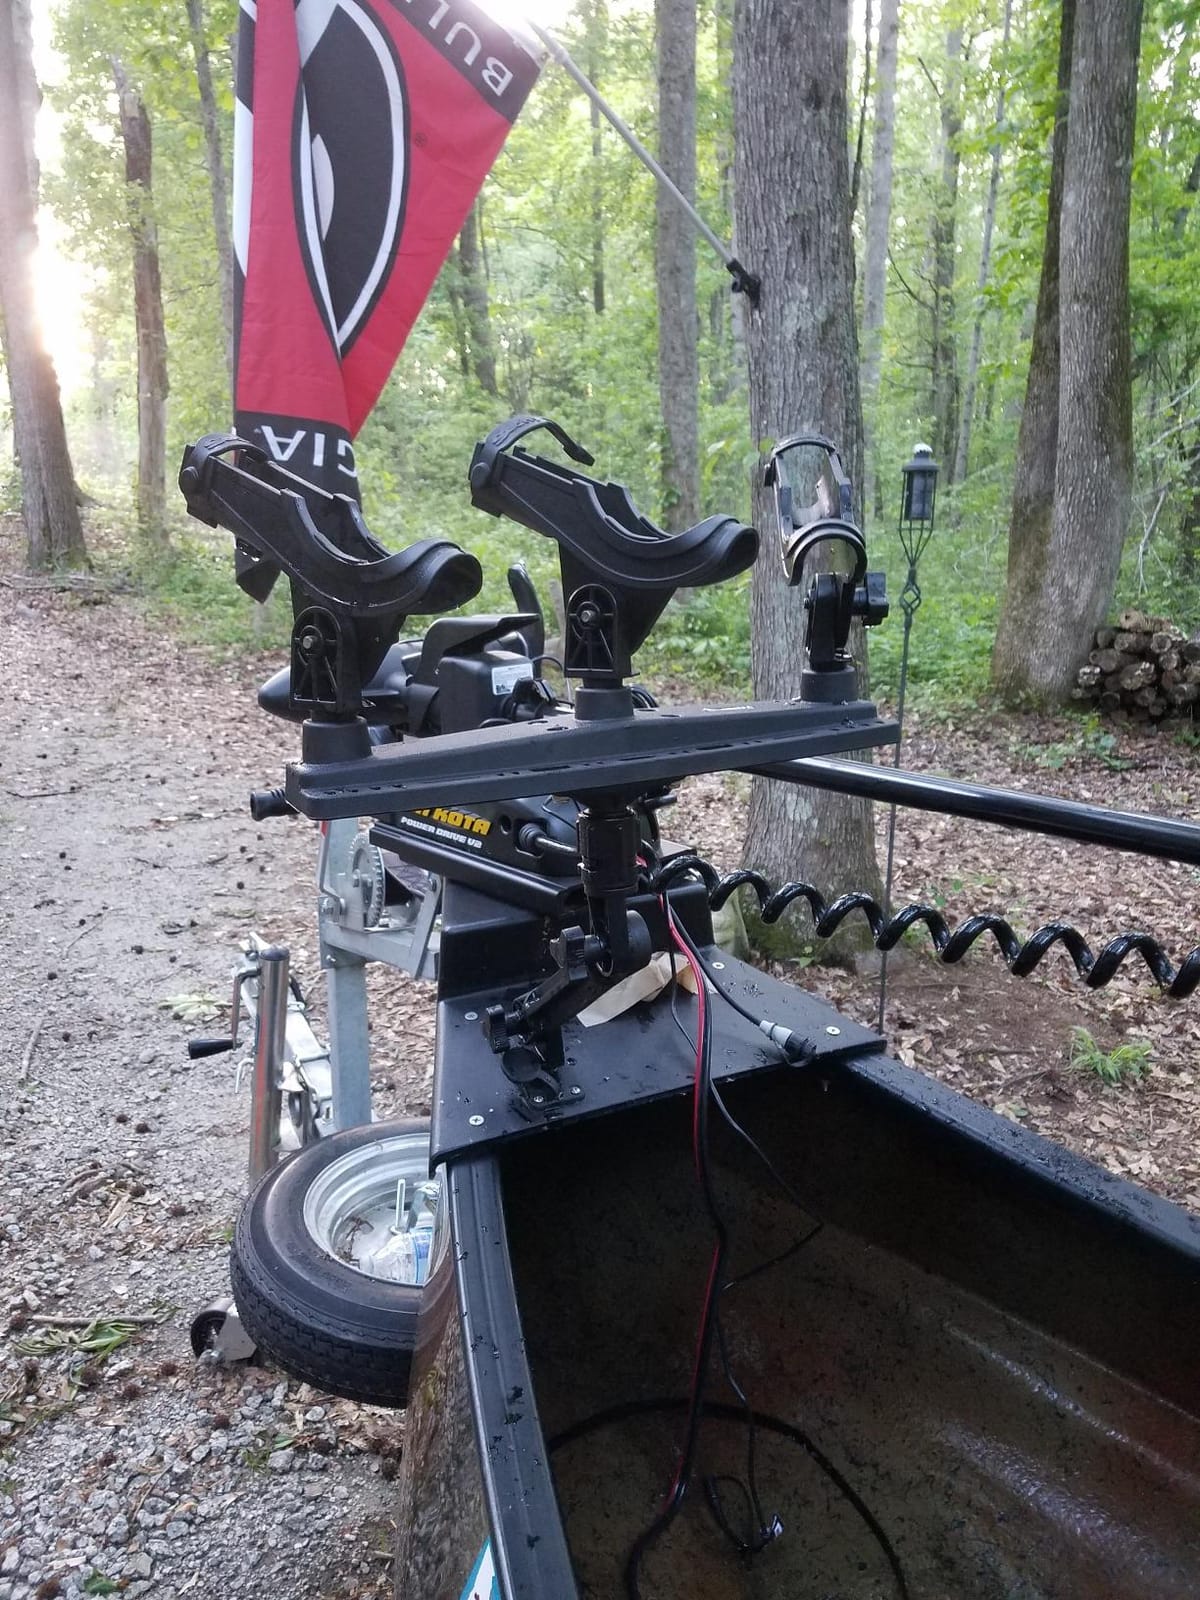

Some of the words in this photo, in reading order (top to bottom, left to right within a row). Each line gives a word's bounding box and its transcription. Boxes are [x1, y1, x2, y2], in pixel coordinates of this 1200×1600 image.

[405, 0, 514, 97] BUL
[400, 816, 435, 833] POWER
[436, 828, 466, 843] DRIVE
[467, 838, 483, 849] V2
[433, 808, 491, 835] KOTA
